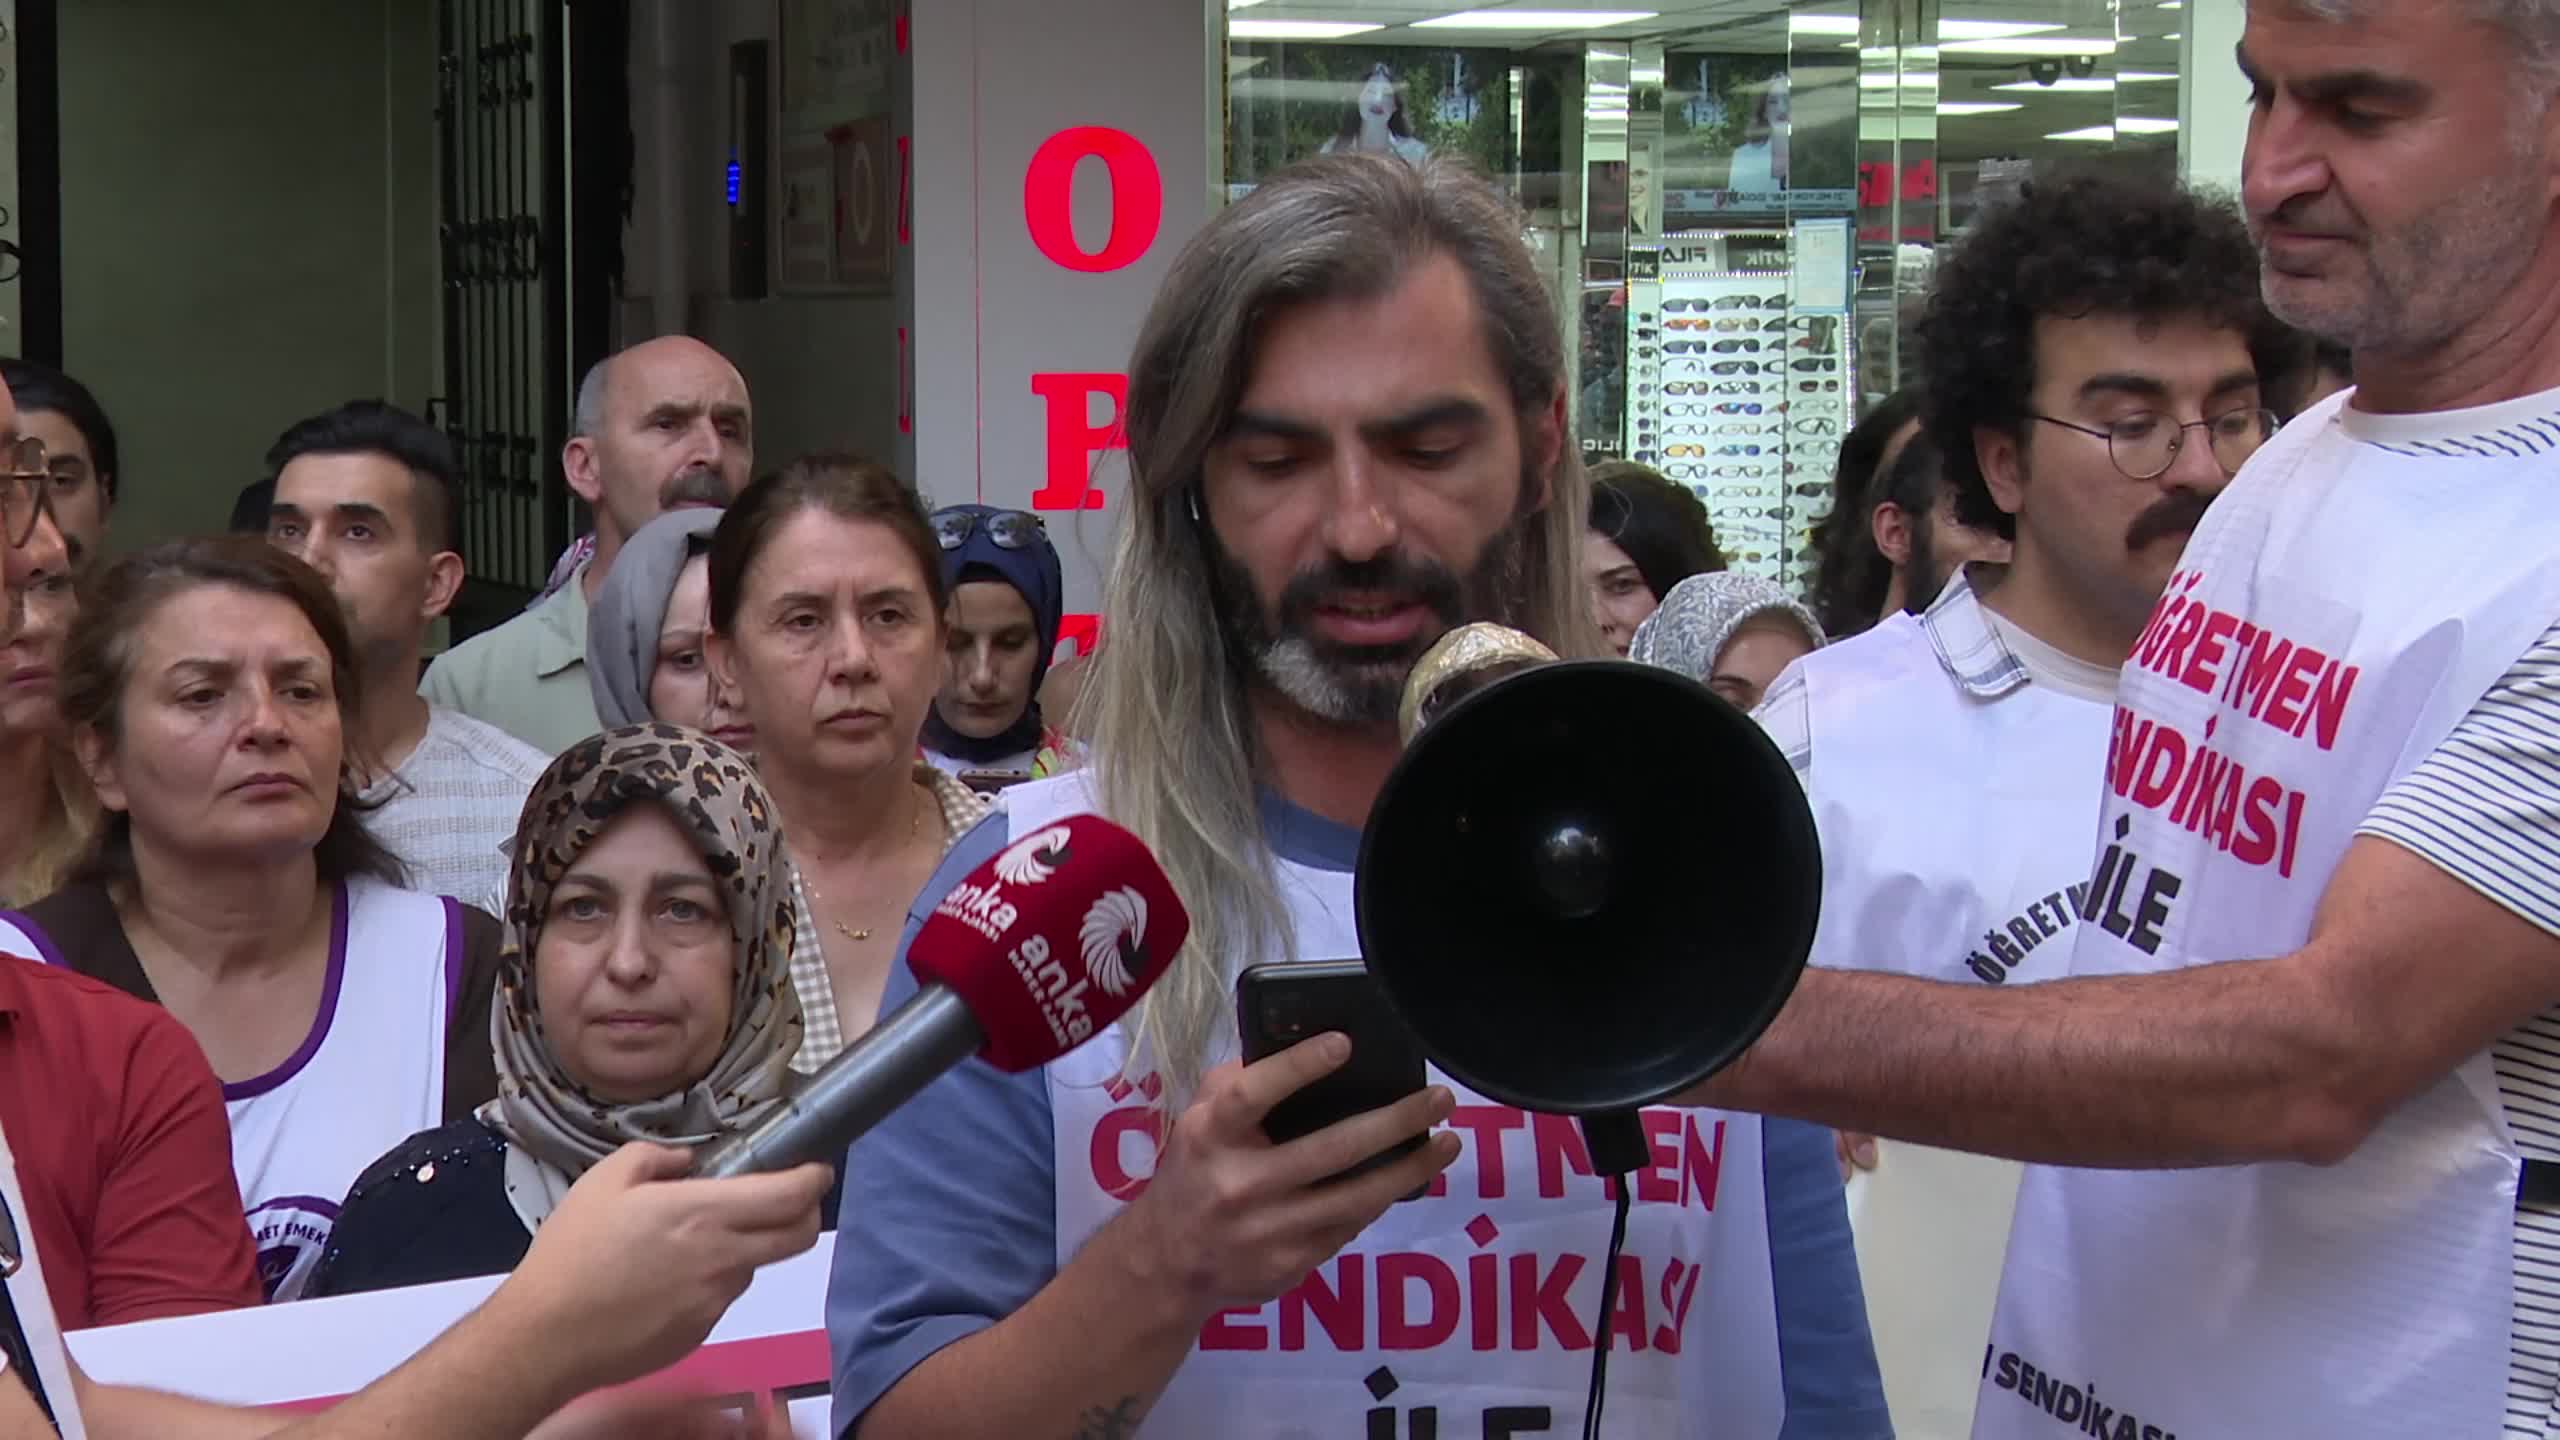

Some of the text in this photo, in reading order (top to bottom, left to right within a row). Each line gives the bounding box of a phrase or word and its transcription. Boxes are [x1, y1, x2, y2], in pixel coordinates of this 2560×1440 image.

[2108, 705, 2306, 879] ENDİKASI
[946, 881, 1018, 933] anka
[2083, 813, 2182, 956] İLE
[1021, 934, 1093, 1045] anka
[1198, 1213, 1701, 1355] ENDİKASI
